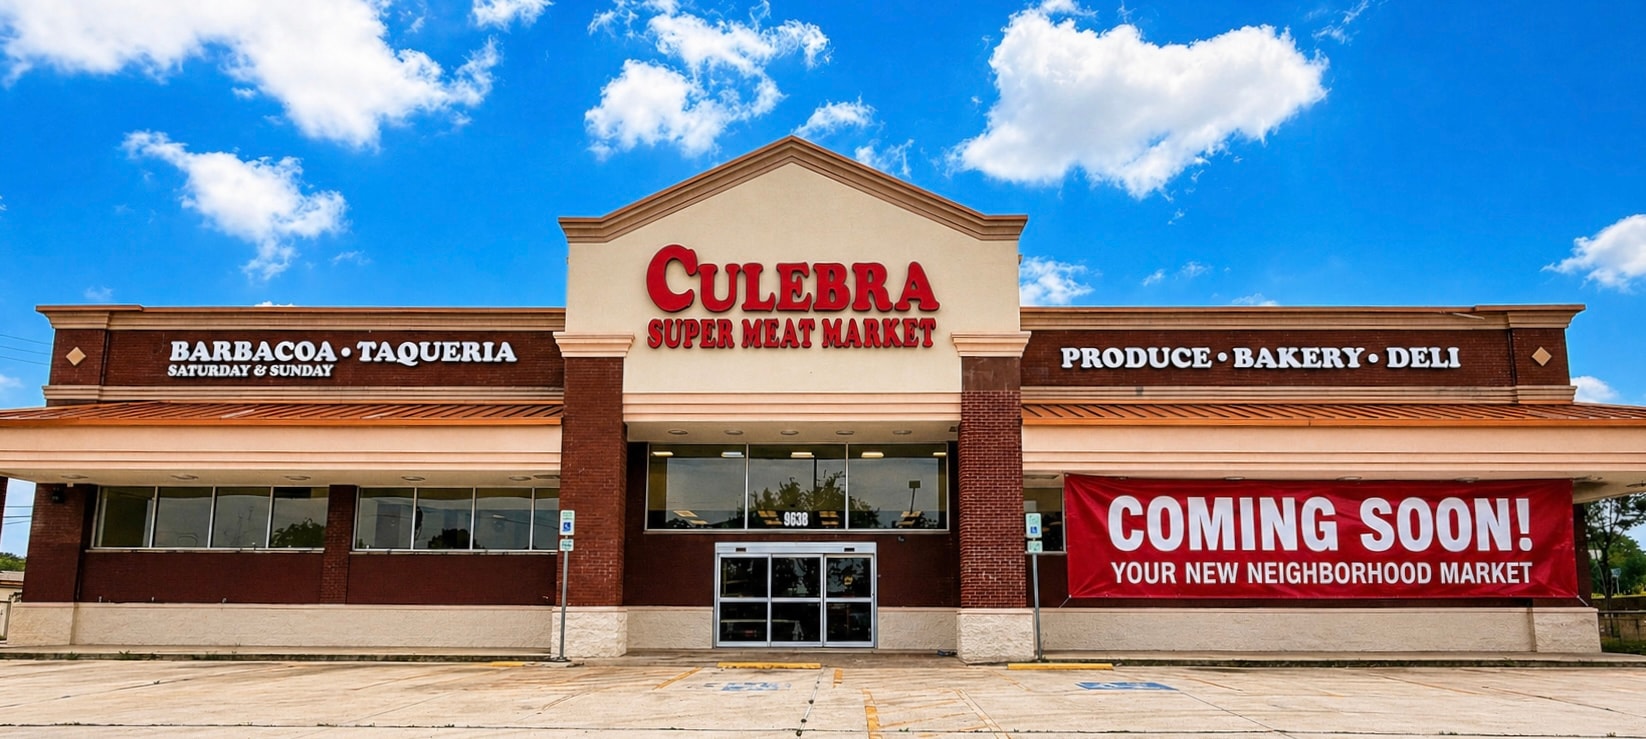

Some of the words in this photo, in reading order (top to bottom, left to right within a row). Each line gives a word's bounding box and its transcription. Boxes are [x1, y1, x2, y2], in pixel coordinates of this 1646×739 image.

[645, 244, 940, 313] CULEBRA
[647, 318, 735, 349] SUPER
[741, 318, 816, 348] MEAT
[821, 317, 937, 348] MARKET
[169, 340, 338, 362] BARBACOA
[356, 341, 518, 367] TAQUERIA
[1060, 347, 1213, 369] PRODUCE
[1232, 347, 1365, 369] BAKERY
[1386, 346, 1461, 368] DELI
[167, 364, 252, 377] SATURDAY
[253, 364, 268, 377] &
[269, 364, 334, 377] SUNDAY
[783, 511, 809, 527] 9638
[1107, 495, 1339, 552] COMING
[1359, 497, 1533, 552] SOON!
[1111, 561, 1177, 584] YOUR
[1185, 562, 1239, 584] NEW
[1247, 561, 1432, 584] NEIGHBORHOOD
[1440, 562, 1533, 584] MARKET
